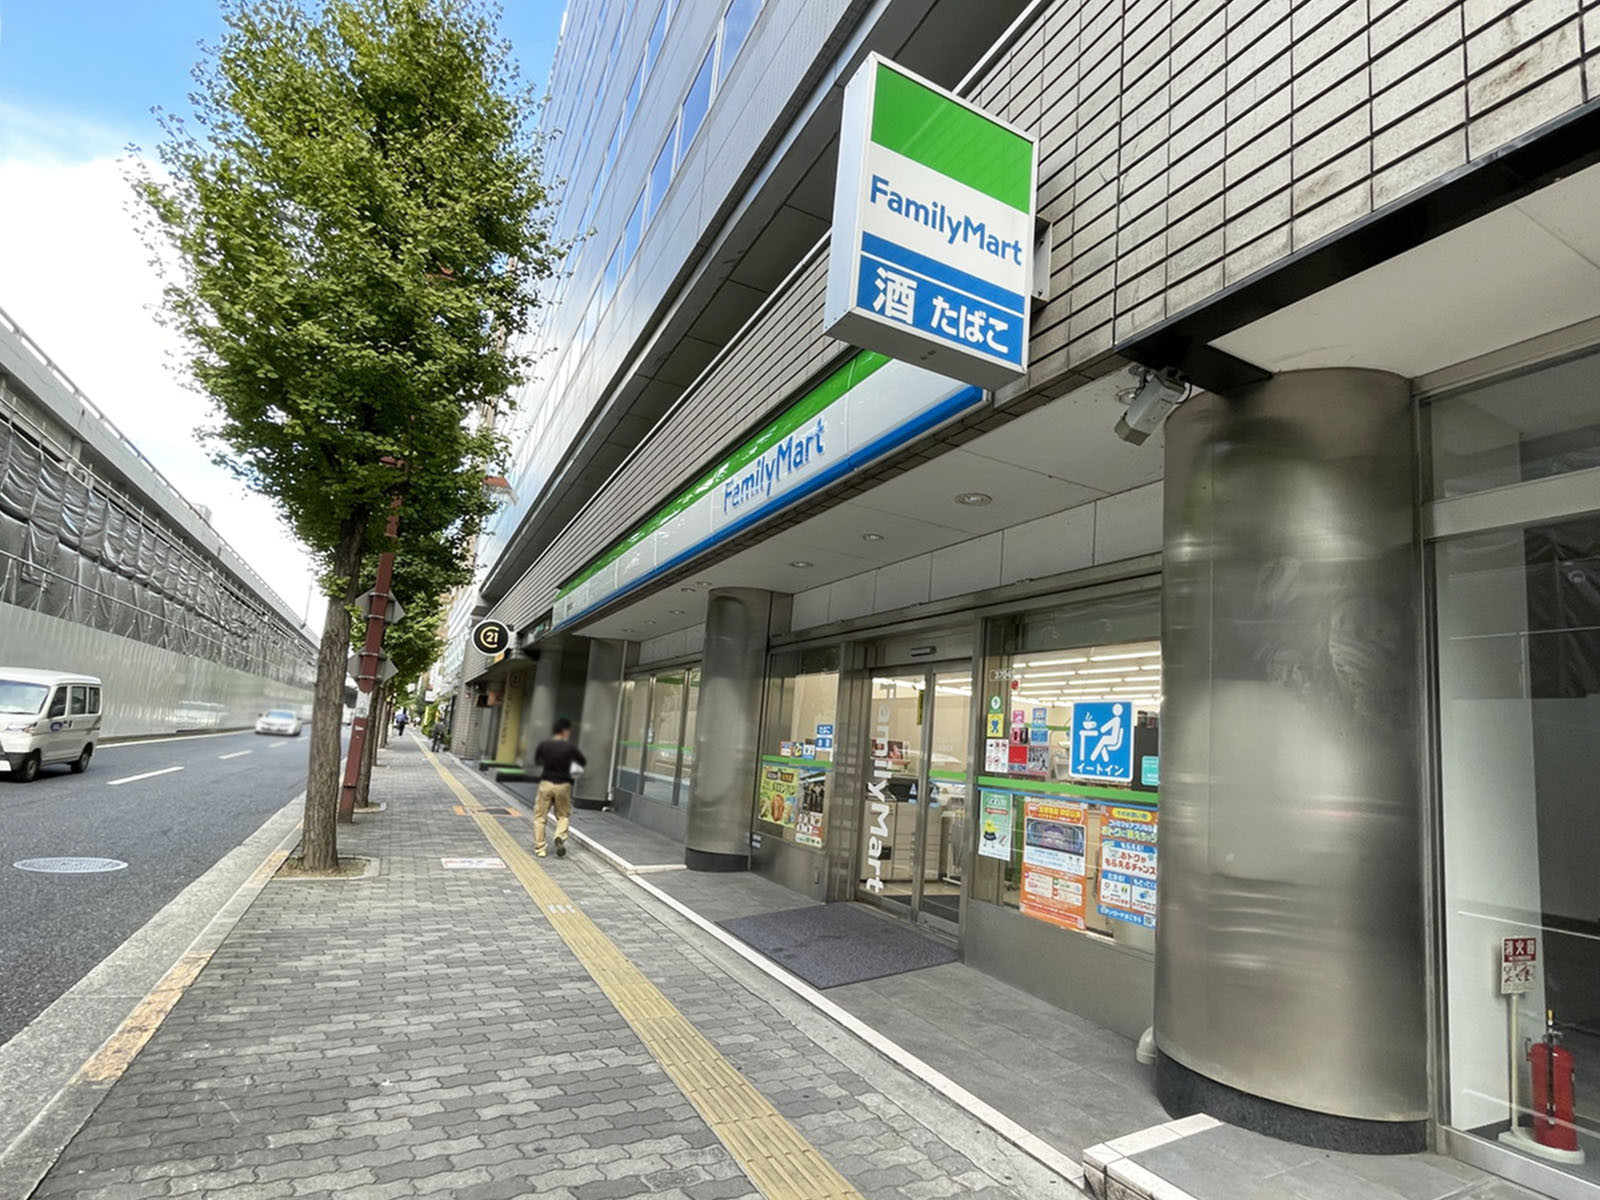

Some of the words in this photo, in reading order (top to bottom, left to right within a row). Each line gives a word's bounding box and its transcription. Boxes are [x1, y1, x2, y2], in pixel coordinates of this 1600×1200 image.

[869, 173, 1022, 267] FamilyMart
[872, 266, 917, 325] 酒
[930, 295, 1009, 354] たばこ
[723, 417, 825, 514] FamilyMart
[866, 682, 897, 894] FamilyMart
[1076, 762, 1124, 777] イートイン
